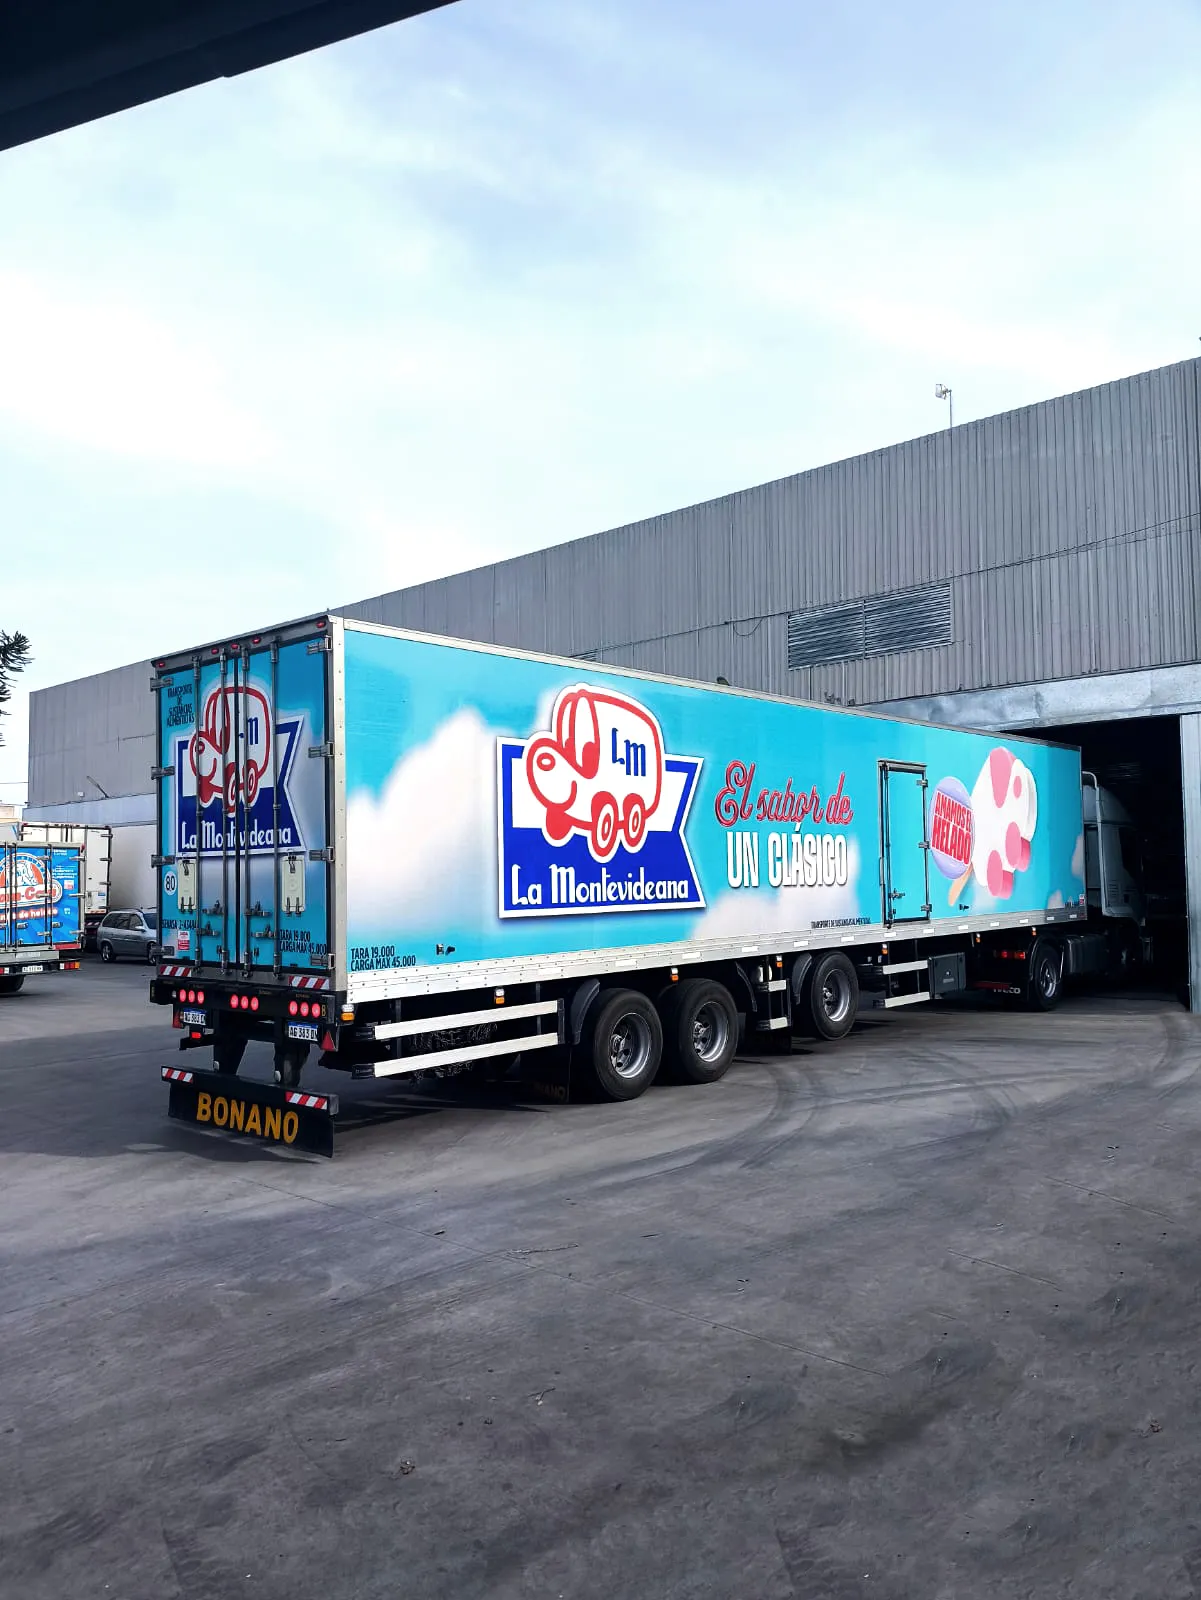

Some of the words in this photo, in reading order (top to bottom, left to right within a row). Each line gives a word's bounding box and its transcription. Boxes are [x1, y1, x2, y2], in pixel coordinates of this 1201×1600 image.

[611, 727, 646, 776] Lm
[715, 760, 755, 827] El
[757, 777, 823, 823] sabor
[825, 772, 853, 824] de
[935, 791, 966, 829] AMAMOS
[181, 821, 197, 849] La
[727, 831, 759, 888] UN
[768, 821, 848, 887] CLÁSICO
[932, 815, 971, 865] HELADO
[166, 875, 176, 891] 80
[512, 864, 542, 905] La
[549, 864, 688, 904] Montevideana
[350, 959, 374, 972] CARGA
[375, 957, 391, 970] MAX
[391, 954, 417, 968] 45.000
[351, 947, 370, 960] TARA
[371, 945, 395, 959] 19.000
[197, 1092, 299, 1144] BONANO
